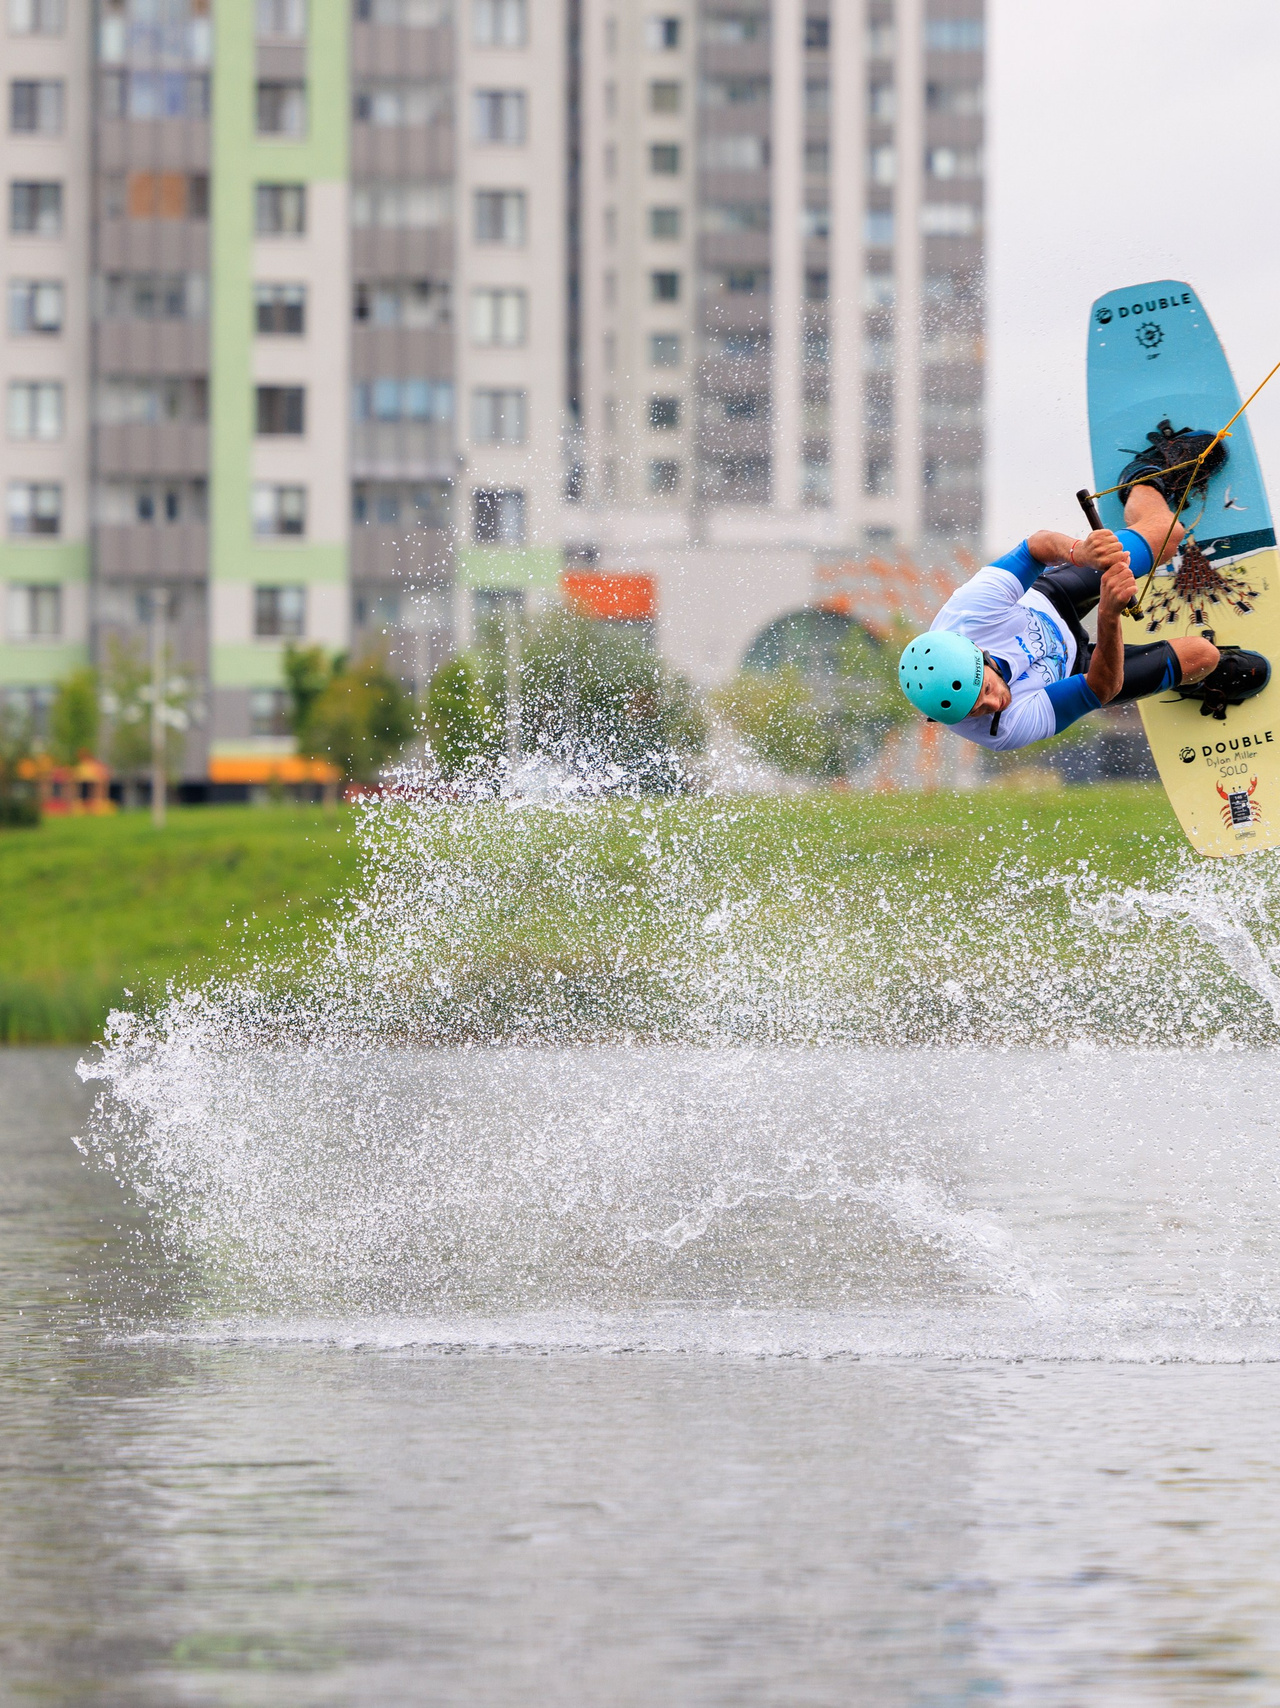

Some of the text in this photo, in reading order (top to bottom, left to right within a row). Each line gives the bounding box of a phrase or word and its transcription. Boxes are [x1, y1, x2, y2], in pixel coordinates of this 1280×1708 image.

[1118, 293, 1191, 318] DOUBLE
[1202, 731, 1274, 757] DOUBLE
[1206, 750, 1258, 767] Dylan Miller
[1219, 763, 1248, 778] SOLO
